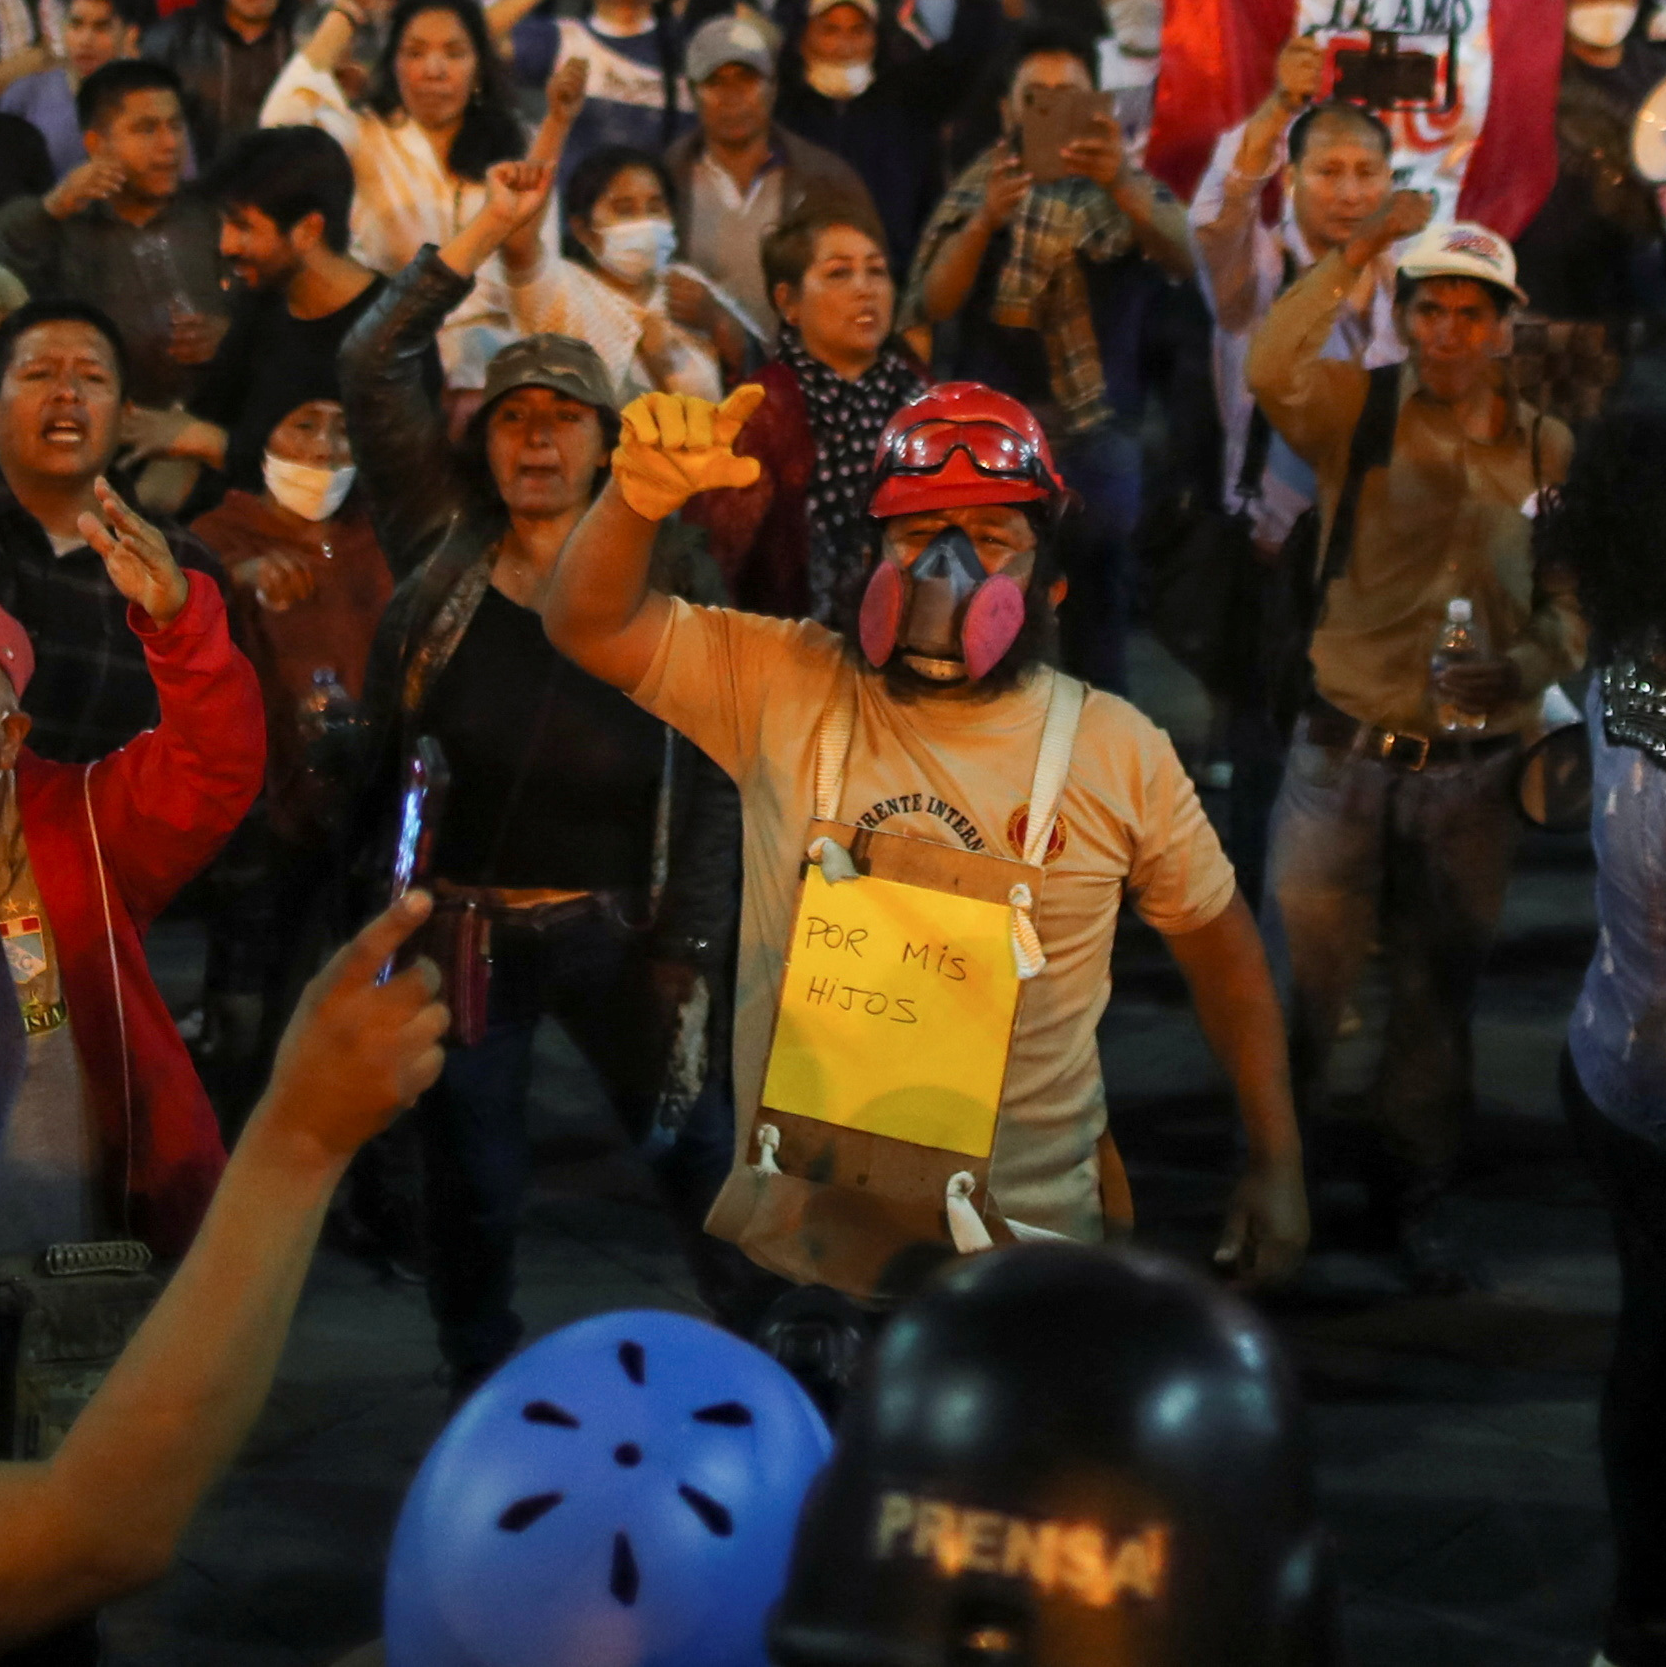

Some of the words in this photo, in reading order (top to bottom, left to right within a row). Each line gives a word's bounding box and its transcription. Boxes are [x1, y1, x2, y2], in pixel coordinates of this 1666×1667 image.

[856, 793, 922, 829] RENTE
[806, 916, 869, 958] POR
[873, 1492, 1167, 1604] PRENSA
